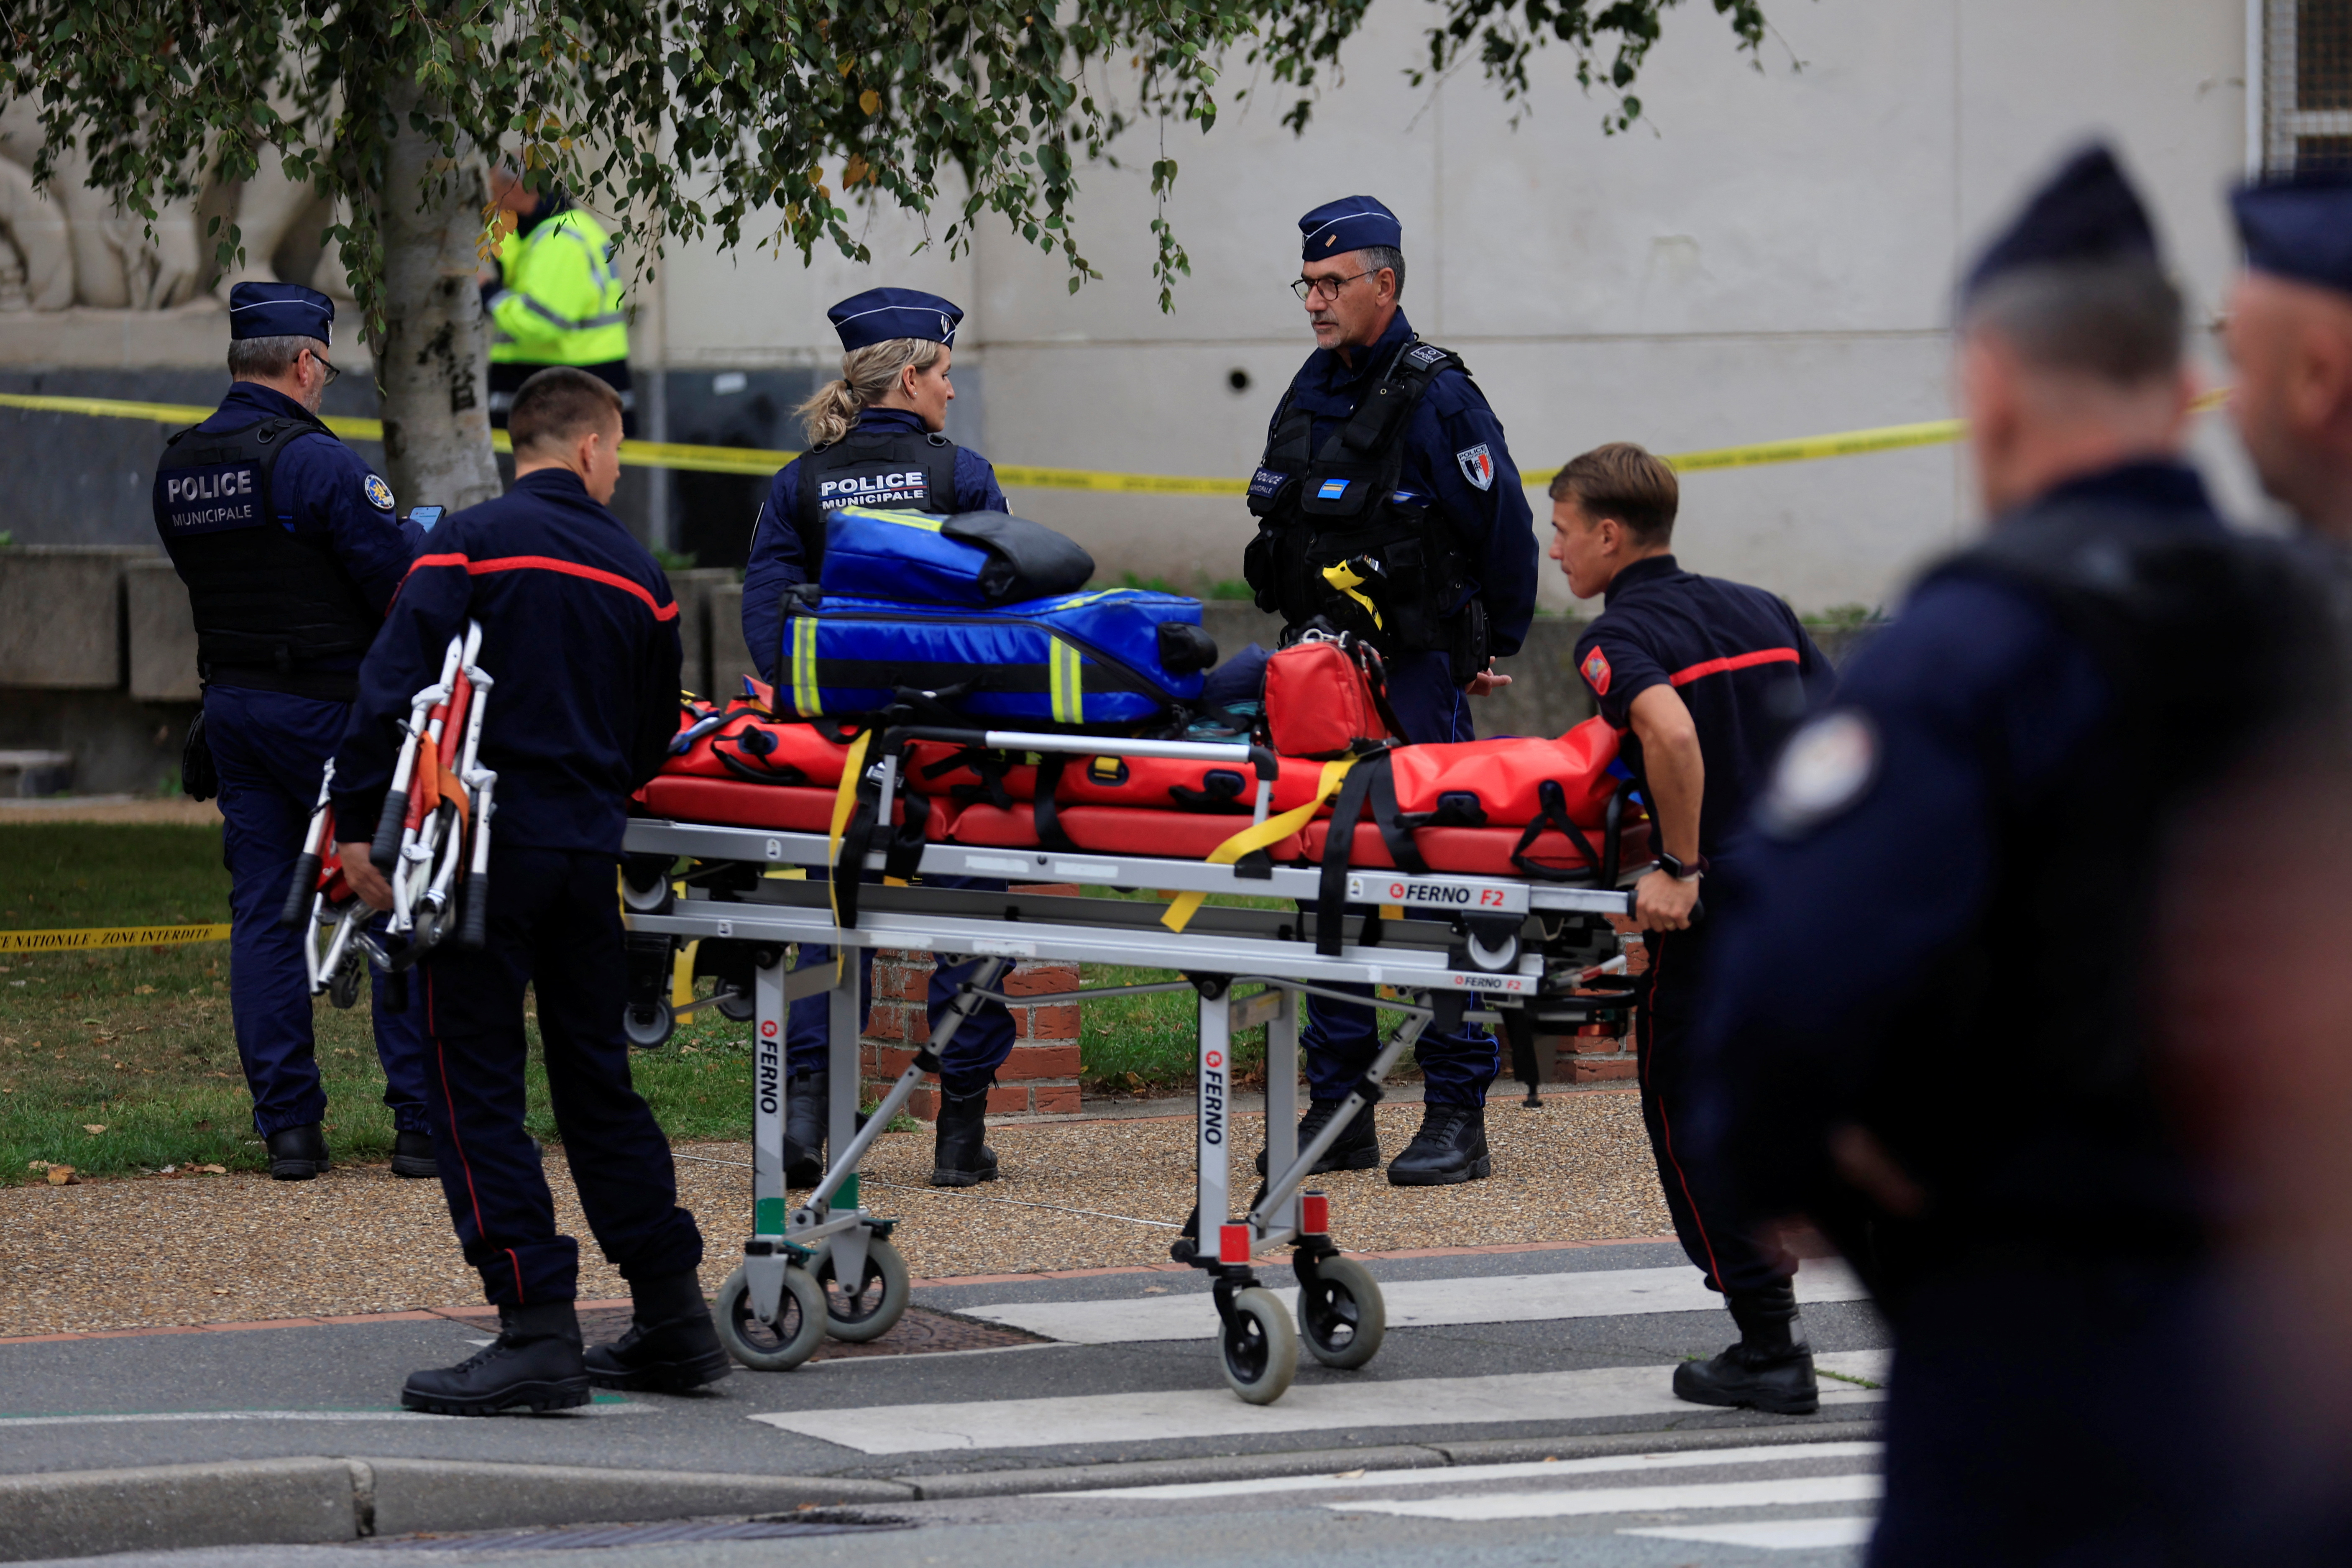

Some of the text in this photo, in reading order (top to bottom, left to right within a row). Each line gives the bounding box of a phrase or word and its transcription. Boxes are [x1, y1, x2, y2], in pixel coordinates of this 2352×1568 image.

[1459, 445, 1486, 459] POLICE
[168, 470, 251, 502] POLICE
[821, 472, 923, 496] POLICE
[1254, 471, 1283, 484] POLICE
[822, 490, 924, 509] MUNICIPALE
[172, 505, 252, 527] MUNICIPALE
[1406, 884, 1504, 906] FERNO F2
[14, 933, 90, 948] NATIONALE
[101, 931, 138, 944] ZONE
[141, 929, 212, 942] INTERDITE
[1465, 977, 1521, 990] FERNO F2
[761, 1040, 777, 1114] FERNO
[1205, 1070, 1222, 1144] FERNO
